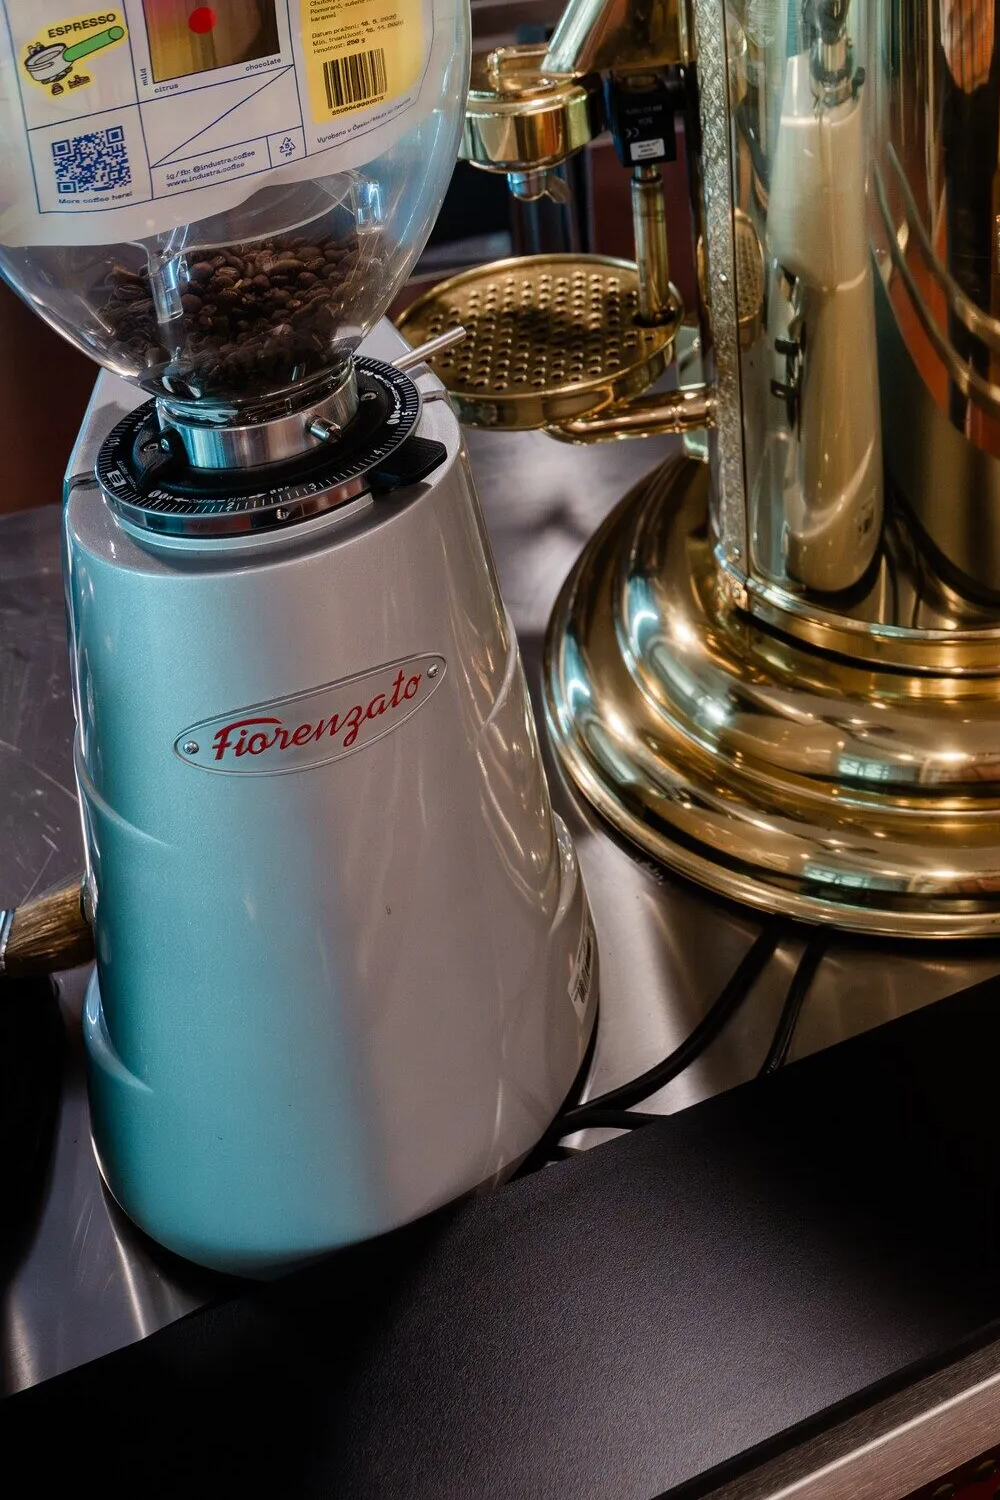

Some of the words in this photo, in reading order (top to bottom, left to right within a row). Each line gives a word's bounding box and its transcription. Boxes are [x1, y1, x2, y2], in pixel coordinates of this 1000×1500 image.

[310, 11, 337, 22] karamel
[48, 13, 116, 38] ESPRESSO
[312, 30, 333, 39] Datum
[313, 42, 346, 54] Hmotnost:
[245, 57, 281, 72] chocolate
[139, 68, 149, 86] mild
[154, 83, 179, 94] citrus
[317, 129, 347, 143] Vyrobeno
[193, 150, 255, 173] @industra.coffee
[166, 162, 245, 187] www.industra.coffee
[83, 196, 110, 204] coffee
[111, 191, 133, 200] here!
[308, 482, 317, 491] 3
[226, 501, 235, 510] 2
[211, 668, 422, 761] Fiorenzato
